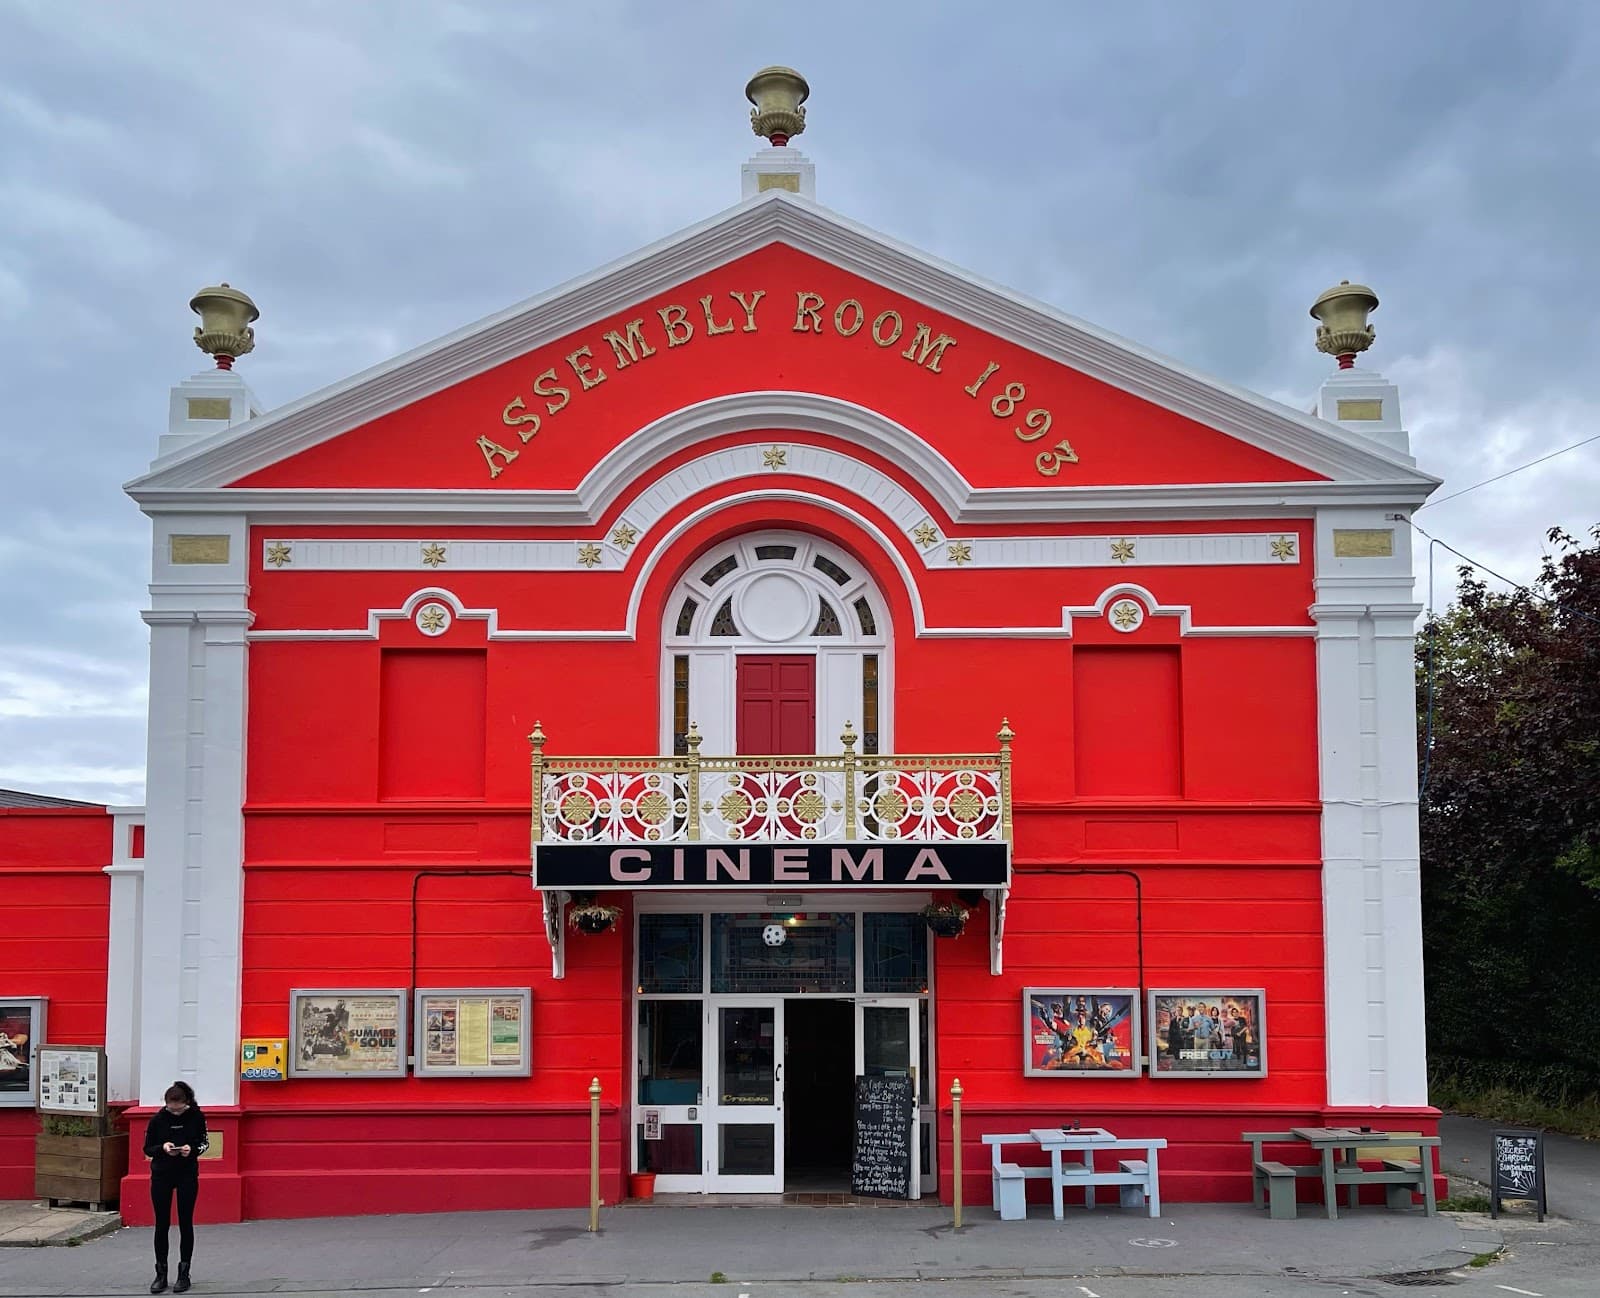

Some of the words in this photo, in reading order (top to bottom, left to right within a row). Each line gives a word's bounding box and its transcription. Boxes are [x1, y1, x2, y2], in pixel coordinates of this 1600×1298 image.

[476, 290, 766, 478] ASSEMBLY
[793, 292, 957, 373] ROOM
[964, 360, 1079, 477] 1893
[609, 848, 952, 882] CINEMA
[349, 1029, 396, 1038] SUMMER
[360, 1038, 396, 1048] SOUL
[1179, 1050, 1208, 1060] FREE
[1210, 1050, 1233, 1060] GUY
[1500, 1147, 1528, 1155] SECRET
